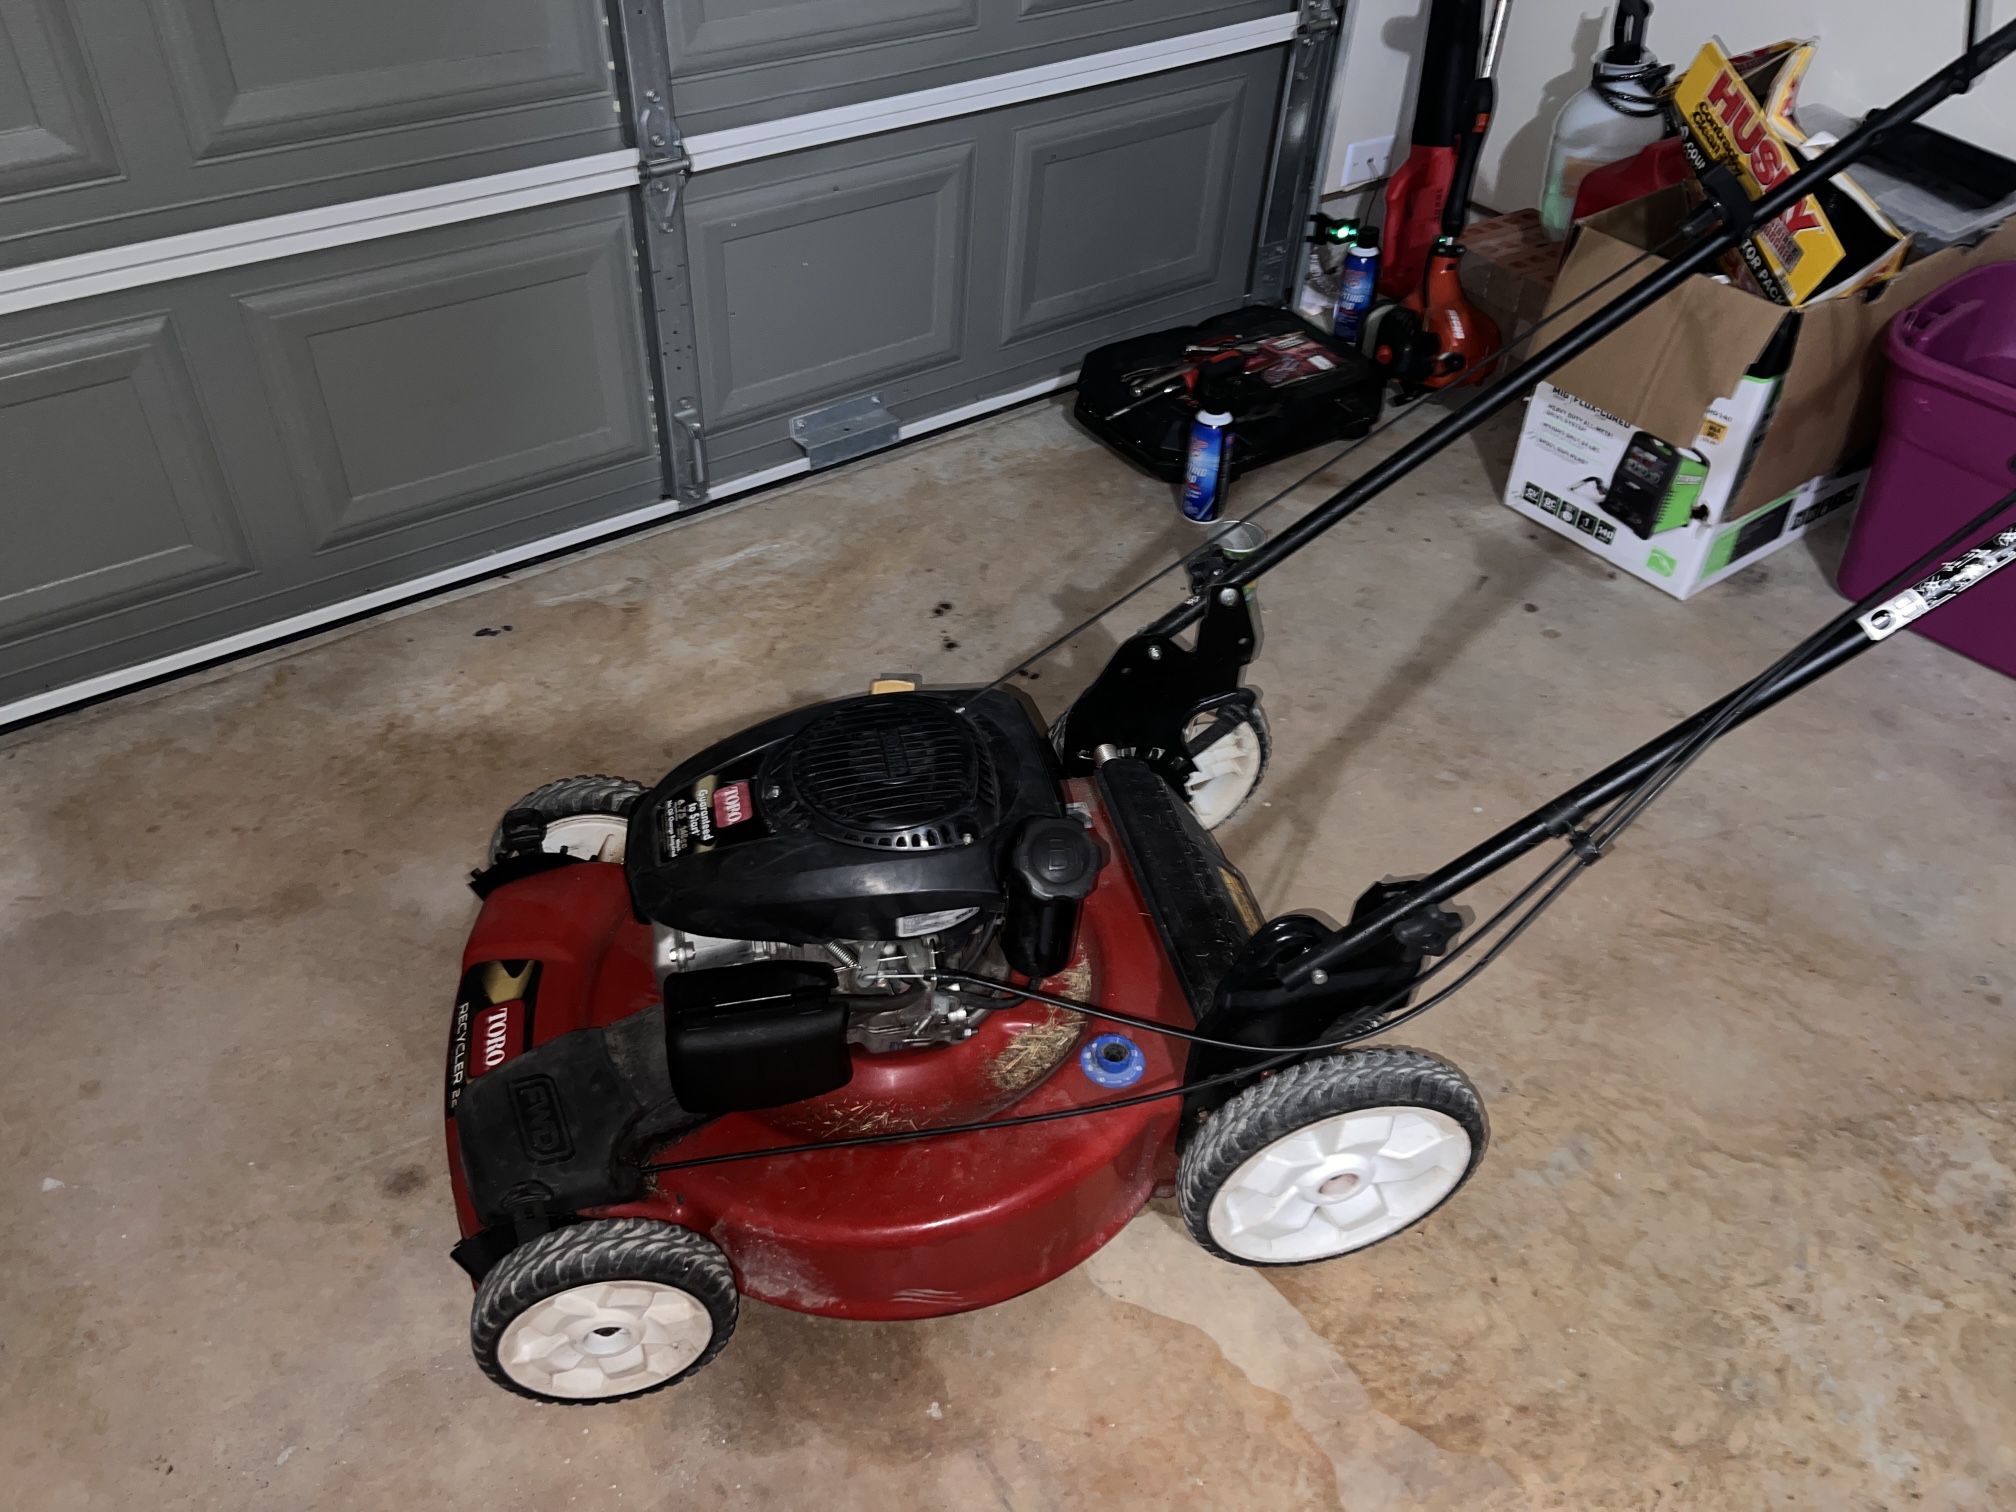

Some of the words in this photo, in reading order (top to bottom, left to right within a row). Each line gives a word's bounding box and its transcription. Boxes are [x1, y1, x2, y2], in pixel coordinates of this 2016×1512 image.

[689, 812, 700, 835] Start
[698, 789, 714, 841] Guaranteed
[725, 786, 742, 823] TORO
[452, 1002, 469, 1085] RECYCLER
[486, 1007, 508, 1067] TORO
